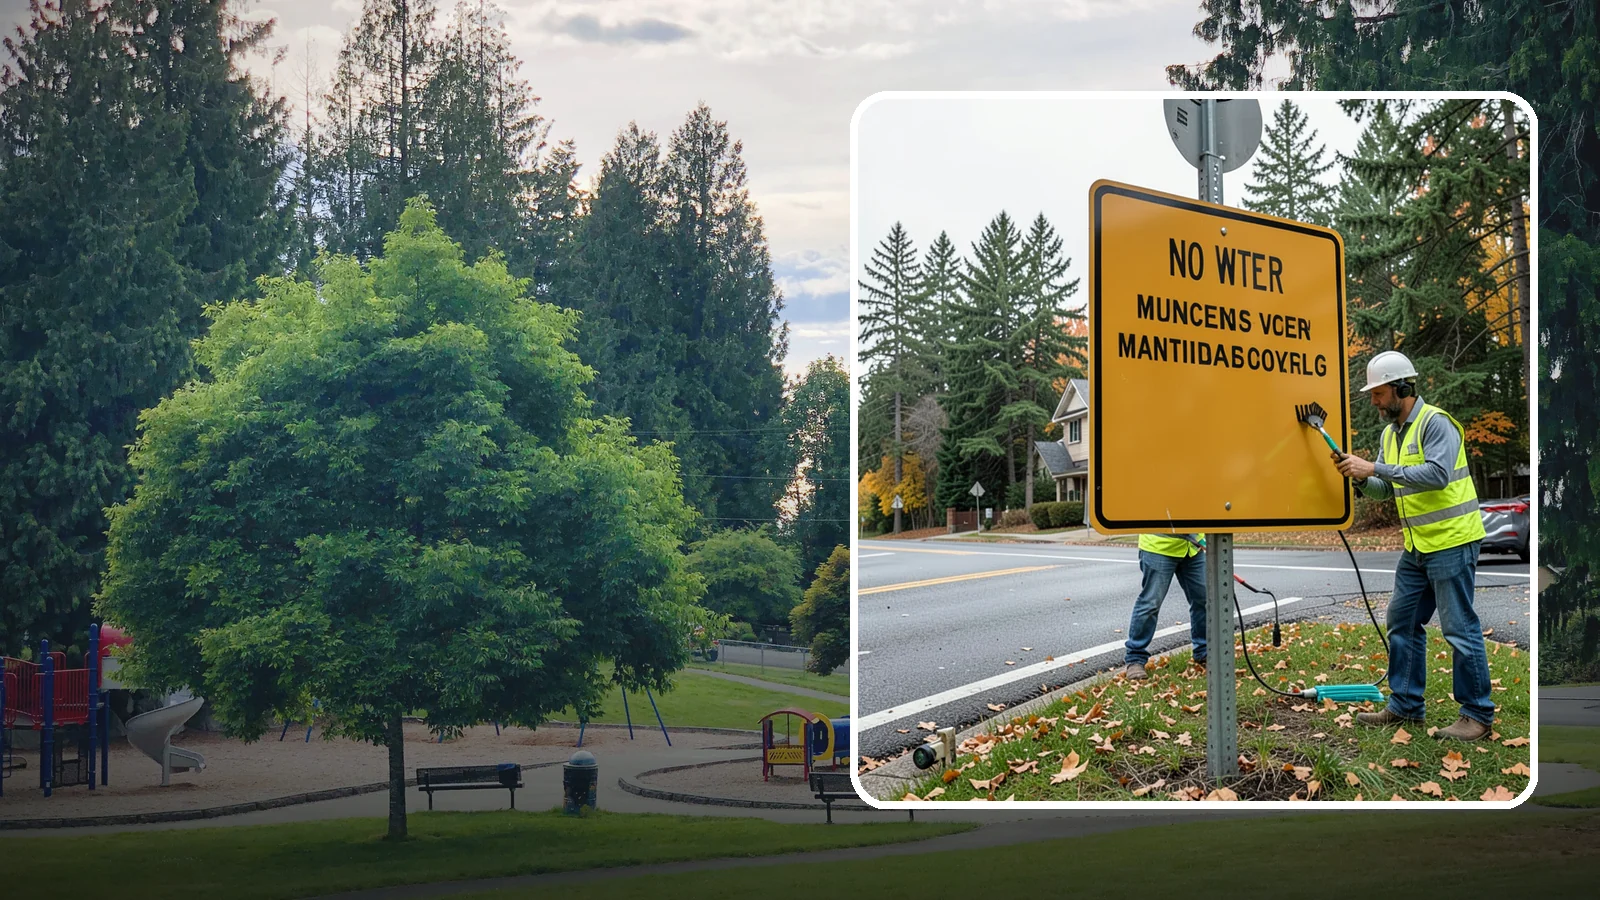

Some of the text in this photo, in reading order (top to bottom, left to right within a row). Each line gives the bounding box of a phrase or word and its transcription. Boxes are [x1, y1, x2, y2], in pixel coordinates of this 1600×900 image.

[1169, 238, 1284, 294] NO WTER
[1137, 294, 1251, 333] MUNCENS
